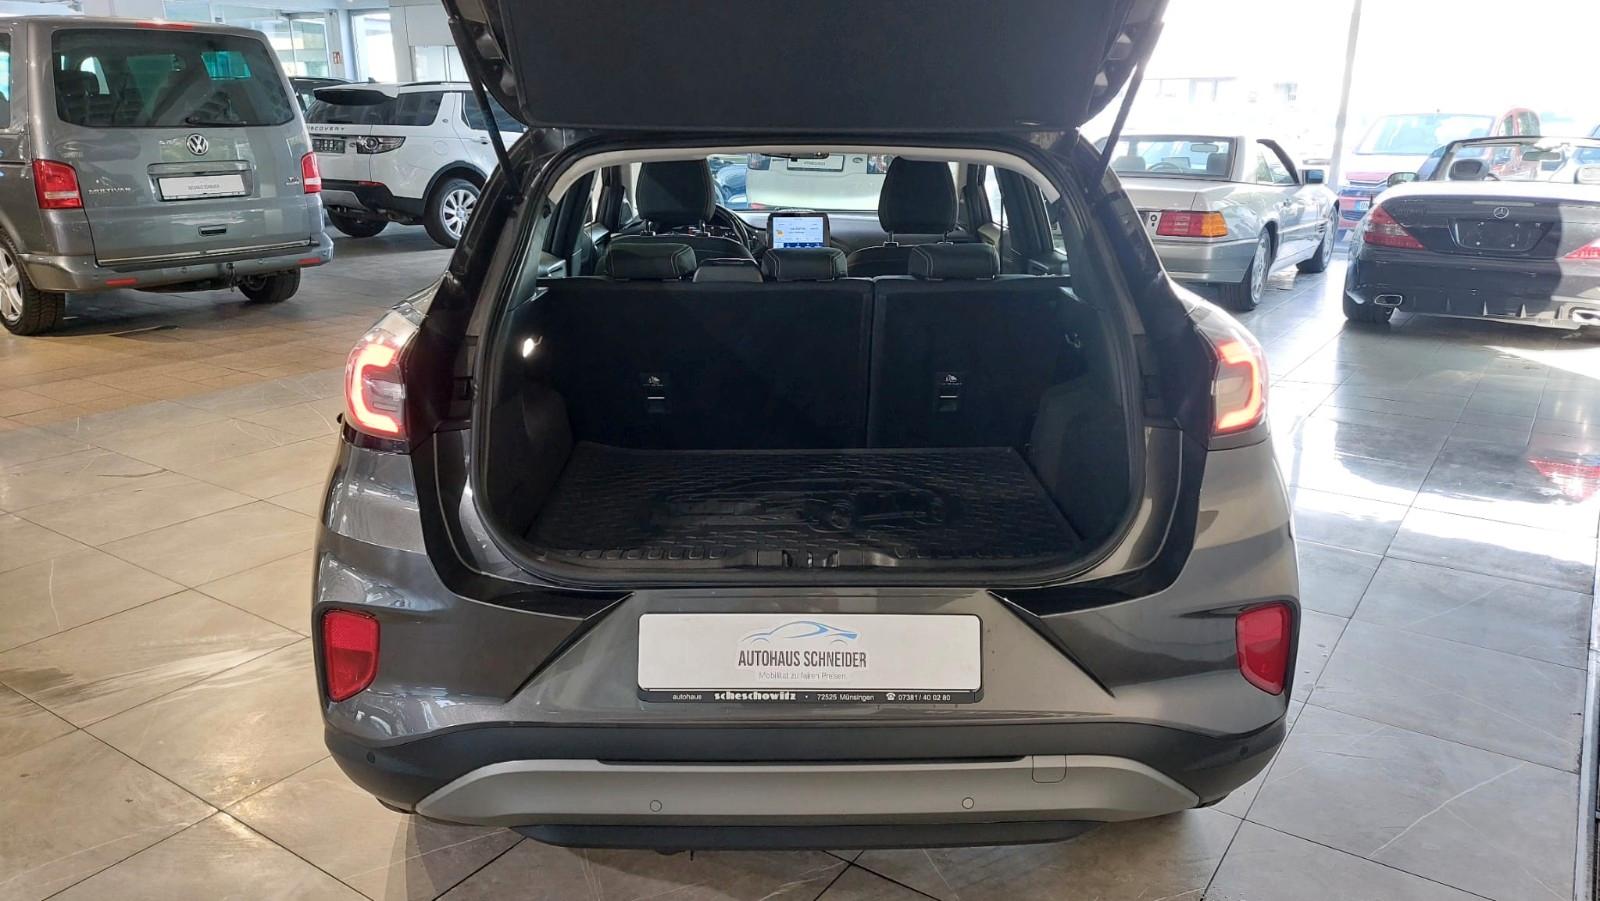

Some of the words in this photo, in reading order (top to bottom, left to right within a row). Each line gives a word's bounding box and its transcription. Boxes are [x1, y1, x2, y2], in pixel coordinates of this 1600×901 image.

[738, 650, 800, 667] AUTOHAUS
[803, 650, 867, 668] SCHNEIDER
[672, 692, 702, 701] autohaus
[714, 691, 797, 701] scheschowitz
[816, 693, 838, 701] 72525
[839, 693, 875, 702] Münsingen
